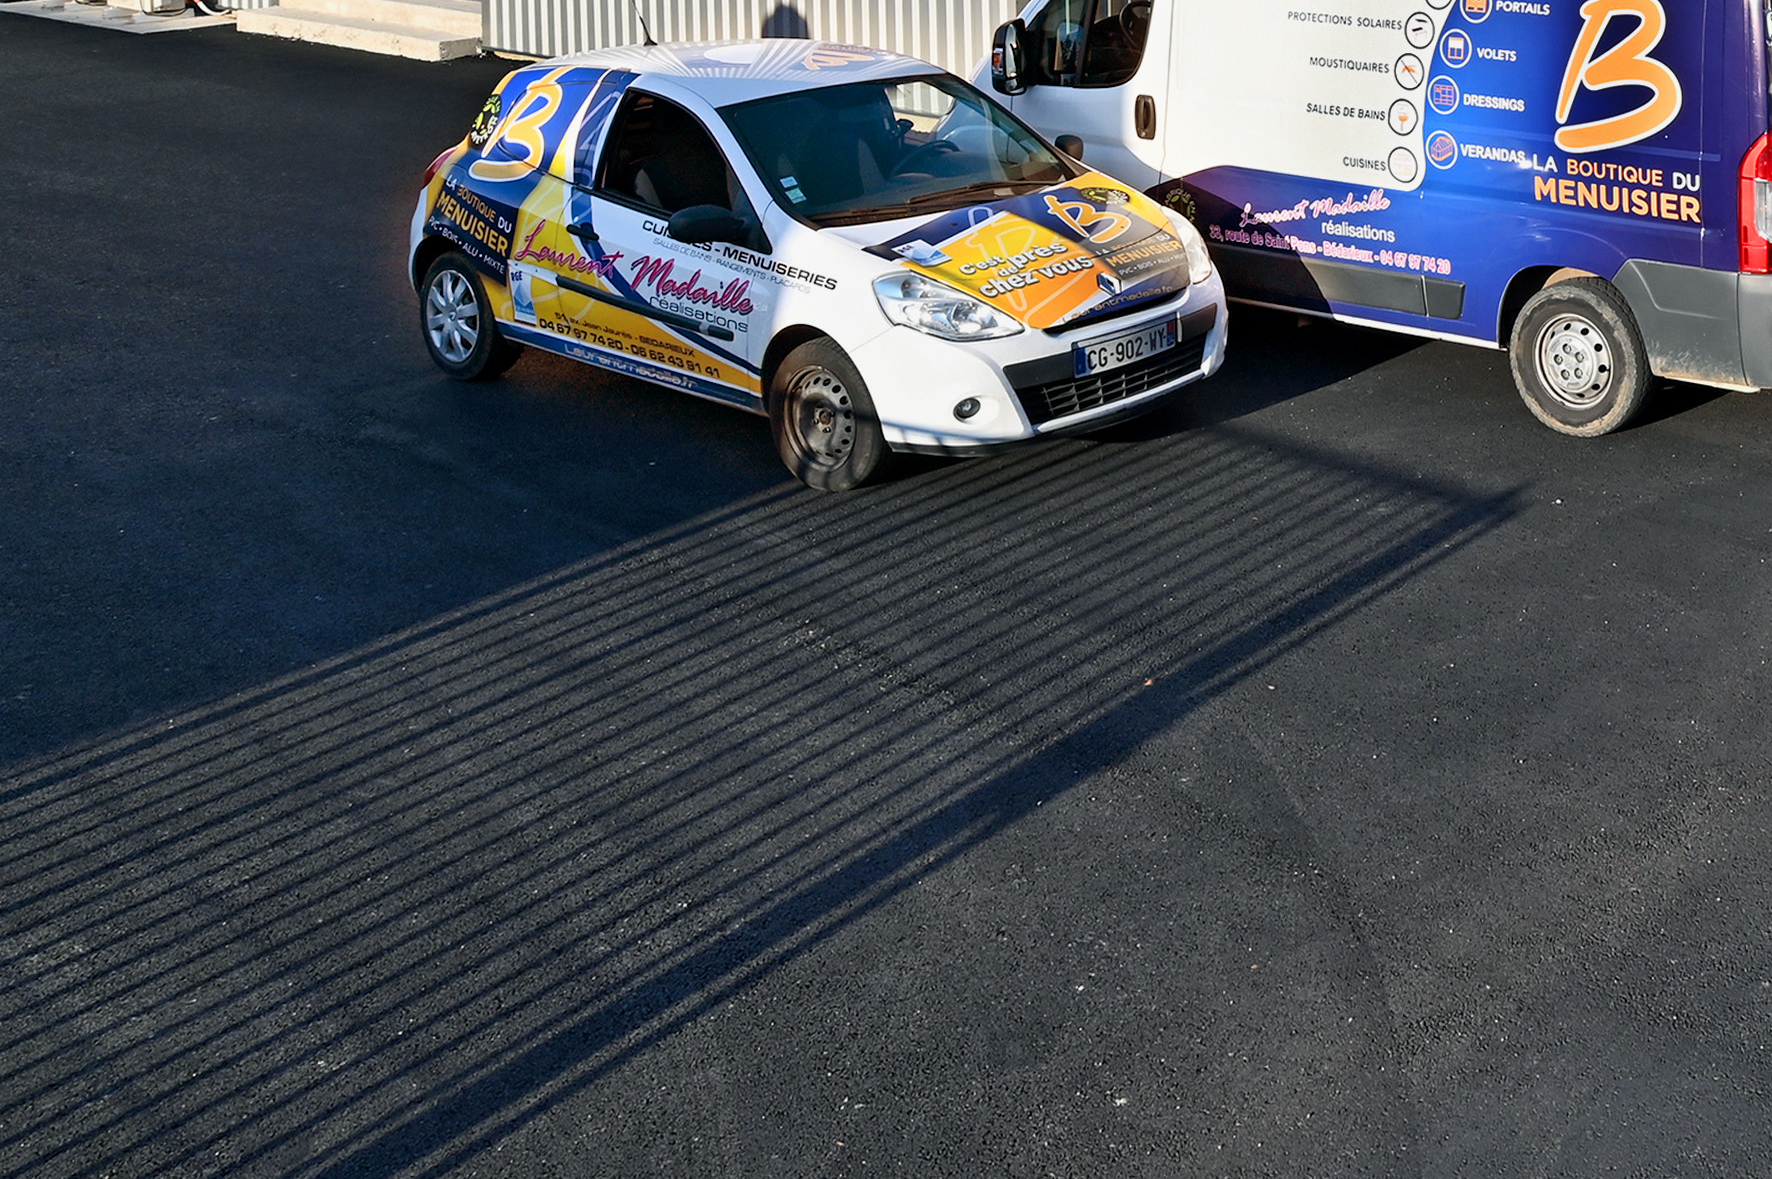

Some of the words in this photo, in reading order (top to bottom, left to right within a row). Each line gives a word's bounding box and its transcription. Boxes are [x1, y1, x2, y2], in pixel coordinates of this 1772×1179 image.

[1288, 11, 1352, 26] PROTECTIONS
[1357, 17, 1402, 30] SOLAIRES
[1496, 0, 1550, 15] PORTAILS
[1310, 56, 1389, 73] MOUSTIQUAIRES
[1477, 47, 1517, 62] VOLETS
[1306, 102, 1340, 116] SALLES
[1343, 106, 1355, 117] DE
[1358, 108, 1386, 121] BAINS
[1463, 93, 1525, 112] DRESSINGS
[1343, 157, 1386, 171] CUISINES
[1460, 143, 1526, 163] VERANDAS
[1532, 154, 1558, 172] LA
[1567, 158, 1664, 186] BOUTIQUE
[1673, 172, 1700, 192] DU
[446, 174, 458, 191] LA
[457, 184, 497, 223] BOUTIQUE
[497, 216, 513, 234] DU
[1239, 202, 1309, 227] Laurent
[1310, 188, 1391, 218] Madaille
[1534, 175, 1702, 223] MENUISIER
[437, 190, 509, 258] MENUISIER
[1321, 219, 1396, 242] réalisations
[442, 227, 459, 244] BOIS
[462, 242, 479, 257] ALU
[483, 254, 505, 275] MIXTE
[1008, 242, 1069, 269] près
[1106, 240, 1182, 268] MENUISIER
[1225, 229, 1250, 244] route
[1251, 230, 1264, 246] de
[1265, 232, 1290, 251] Saint
[1291, 236, 1317, 254] Pons
[1380, 249, 1394, 266] 04
[1394, 252, 1407, 268] 67
[1408, 254, 1422, 271] 97
[1423, 256, 1436, 273] 74
[1437, 258, 1452, 275] 20
[511, 270, 523, 282] RGE
[515, 219, 625, 279] Laurent
[631, 253, 755, 316] Madaille
[722, 246, 838, 291] MENUISERIES
[979, 271, 1040, 298] chez
[1039, 254, 1095, 279] vous
[998, 265, 1020, 277] de
[1119, 266, 1135, 276] PVC
[650, 295, 749, 333] réalisations
[539, 318, 554, 330] 04
[556, 322, 571, 335] 67
[590, 331, 604, 345] 74
[607, 336, 624, 351] 20
[649, 350, 666, 364] 62
[668, 355, 684, 369] 43
[705, 365, 720, 379] 41
